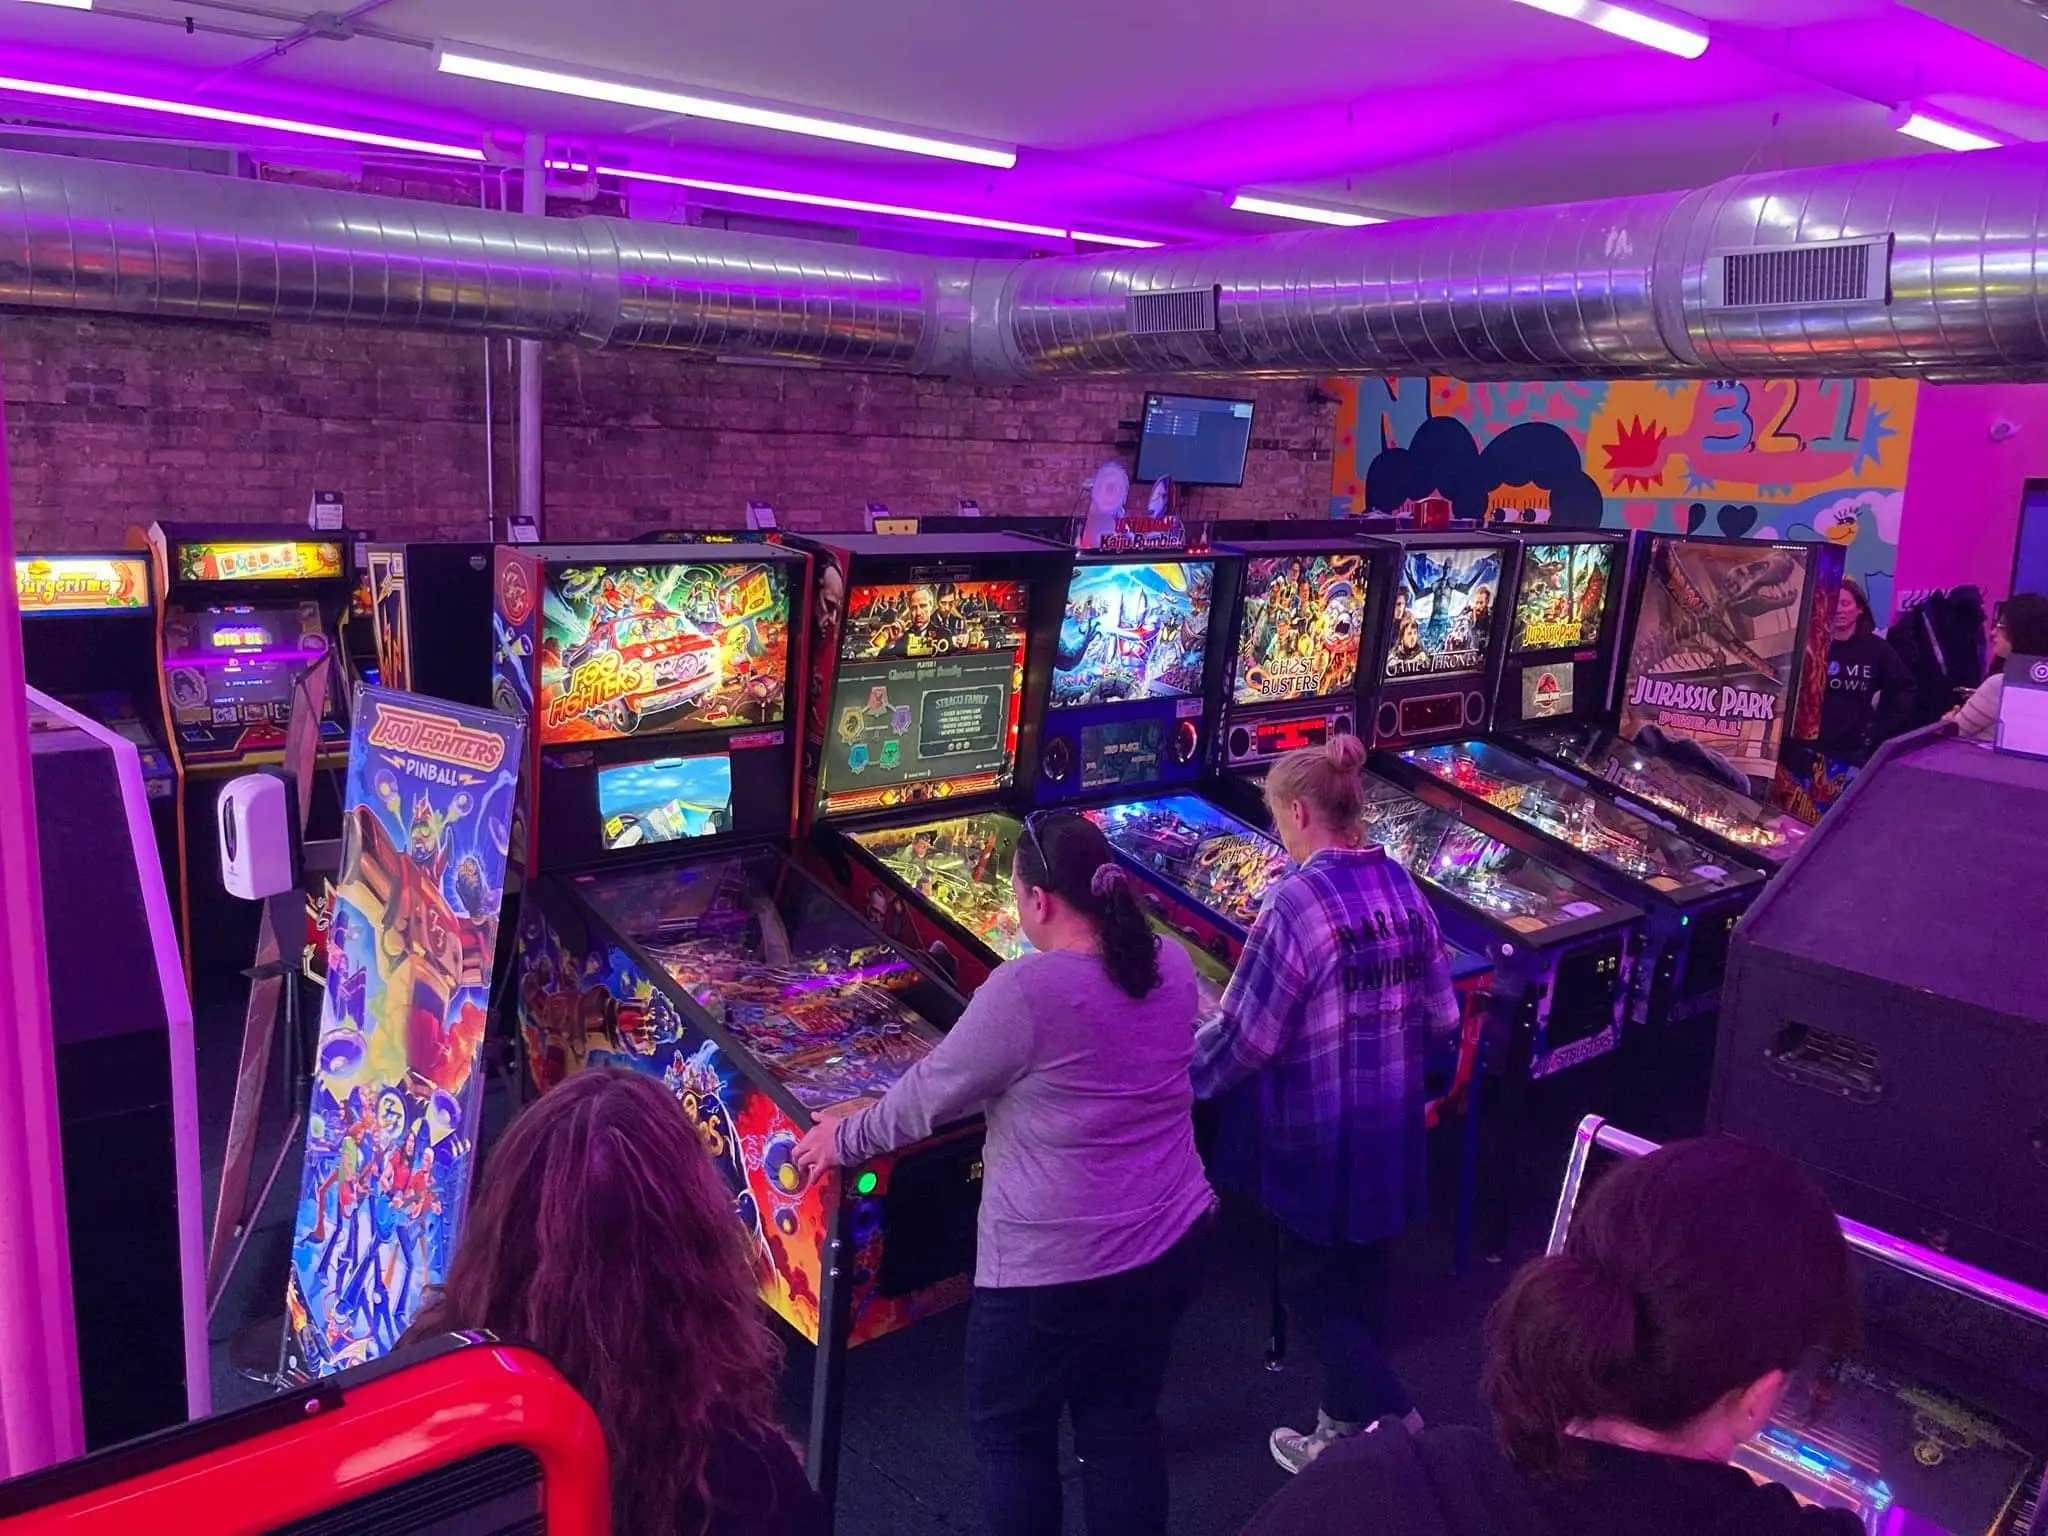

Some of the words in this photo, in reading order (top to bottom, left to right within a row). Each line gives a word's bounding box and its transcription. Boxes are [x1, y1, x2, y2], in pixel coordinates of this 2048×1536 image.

[549, 664, 642, 727] FIGHTERS
[1261, 674, 1320, 695] BUSTERS
[1630, 675, 1719, 713] JURASSIC
[1719, 685, 1776, 720] PARK
[379, 716, 413, 743] FOO
[1658, 710, 1741, 736] PINBALL
[406, 759, 458, 787] PINBALL
